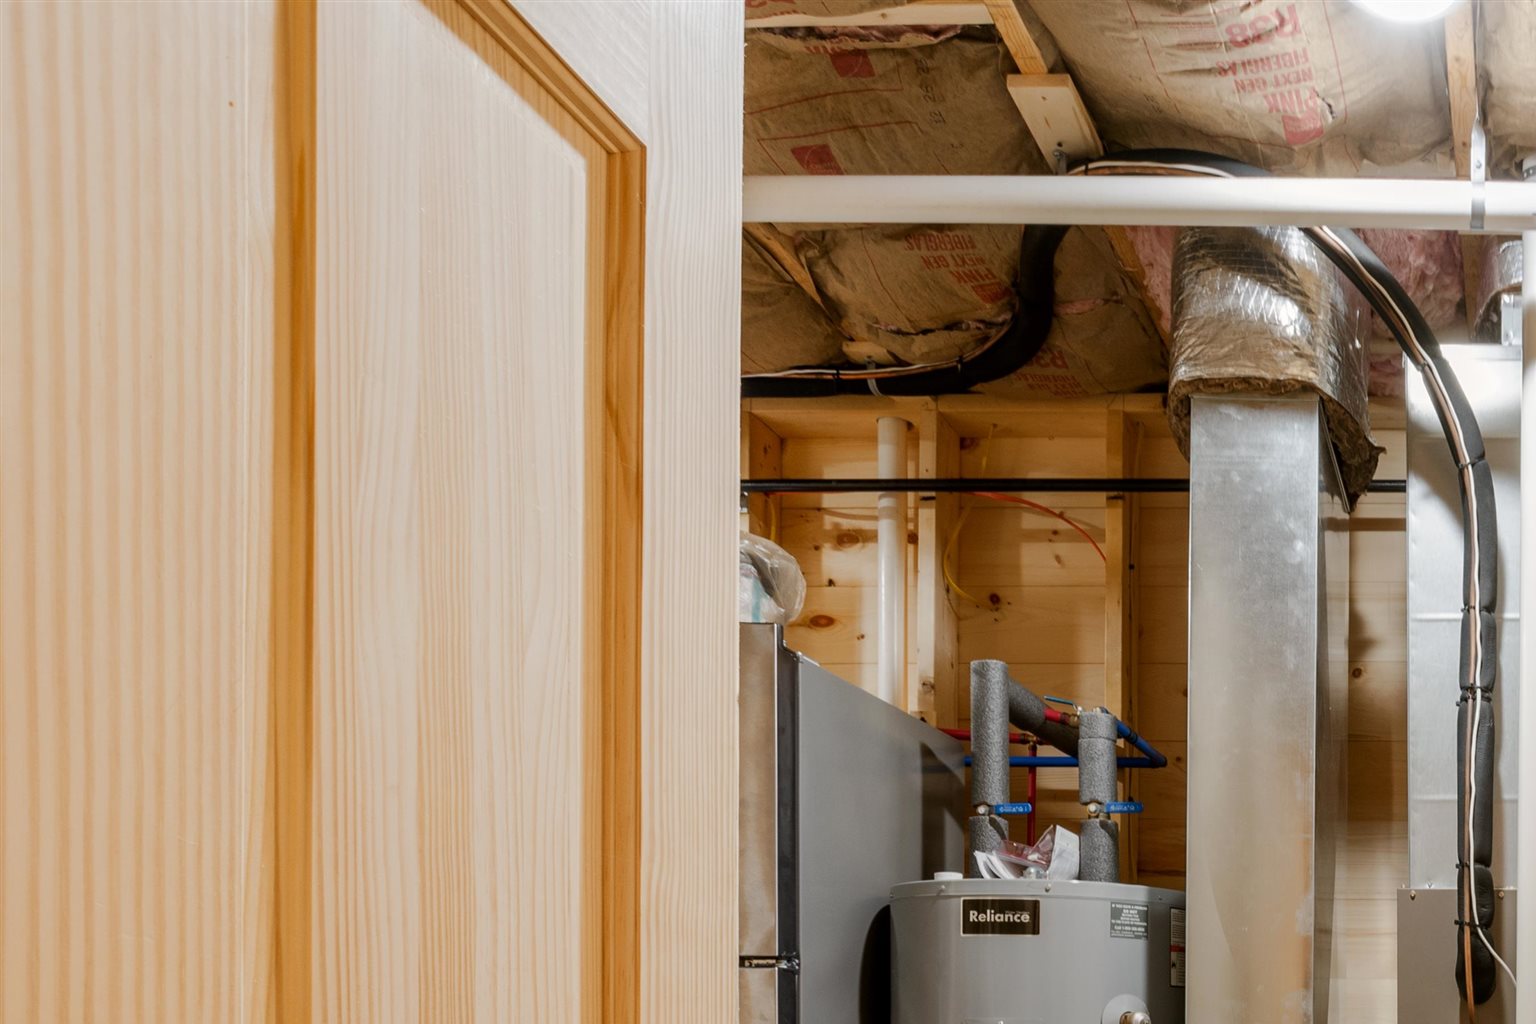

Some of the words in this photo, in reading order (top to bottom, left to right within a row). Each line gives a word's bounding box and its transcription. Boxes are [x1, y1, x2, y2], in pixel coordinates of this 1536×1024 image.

[1234, 77, 1268, 94] GEN
[1273, 67, 1313, 88] NEXT
[1264, 86, 1318, 113] PINK
[904, 233, 977, 251] FIBERGLAS
[920, 255, 949, 270] GEN
[950, 267, 997, 284] PINK
[1024, 347, 1069, 369] R3
[969, 909, 1030, 923] Reliance
